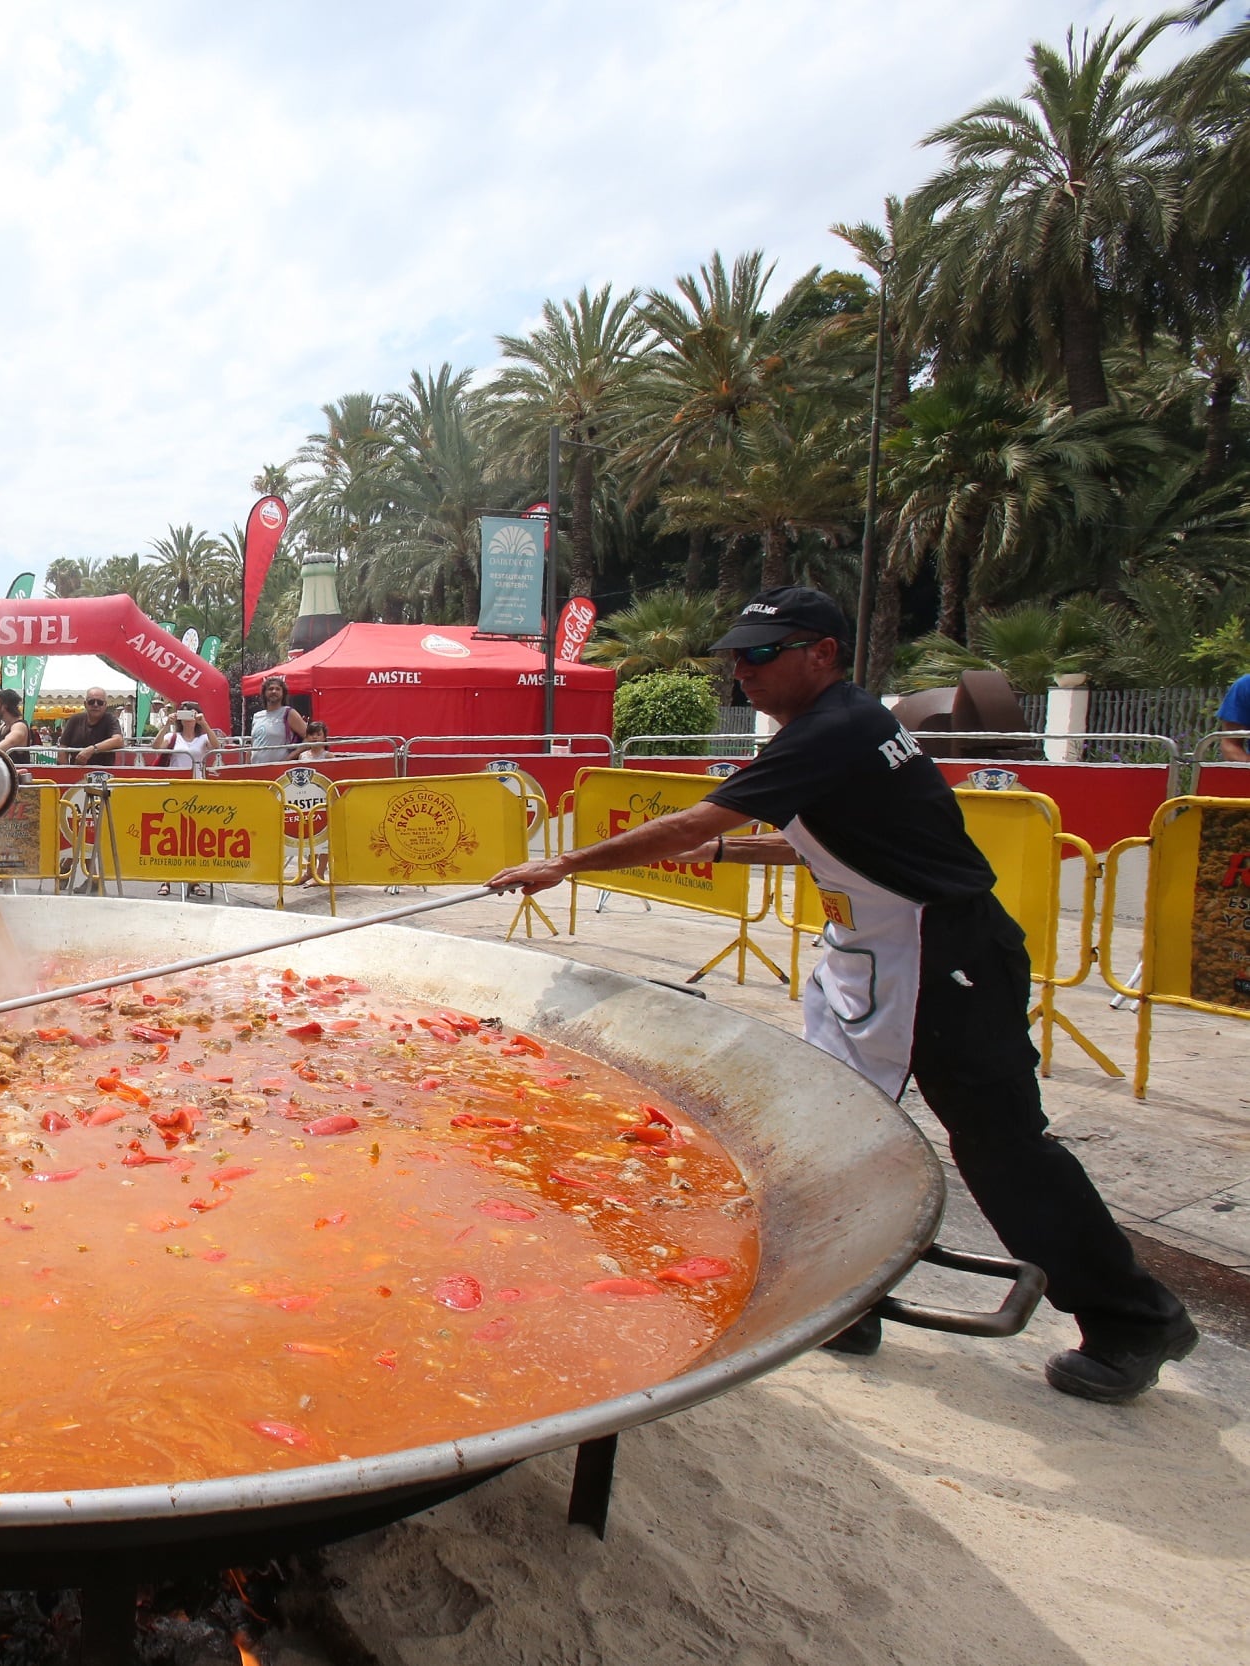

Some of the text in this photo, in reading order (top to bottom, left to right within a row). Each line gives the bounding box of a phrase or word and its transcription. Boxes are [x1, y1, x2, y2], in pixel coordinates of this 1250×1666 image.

[126, 633, 203, 689] AMSTEL
[367, 671, 421, 684] AMSTEL
[517, 674, 566, 686] AMSEL
[162, 795, 237, 824] Arroz
[388, 792, 455, 823] PAELLAS GIGANTES
[397, 803, 446, 828] RIQUELME
[126, 812, 251, 858] la Fallera
[595, 821, 607, 839] la
[139, 857, 147, 865] EL
[150, 857, 182, 866] PREFERIDO
[184, 857, 197, 866] POR
[662, 873, 672, 883] LOS
[675, 874, 714, 891] VALENCIANOS
